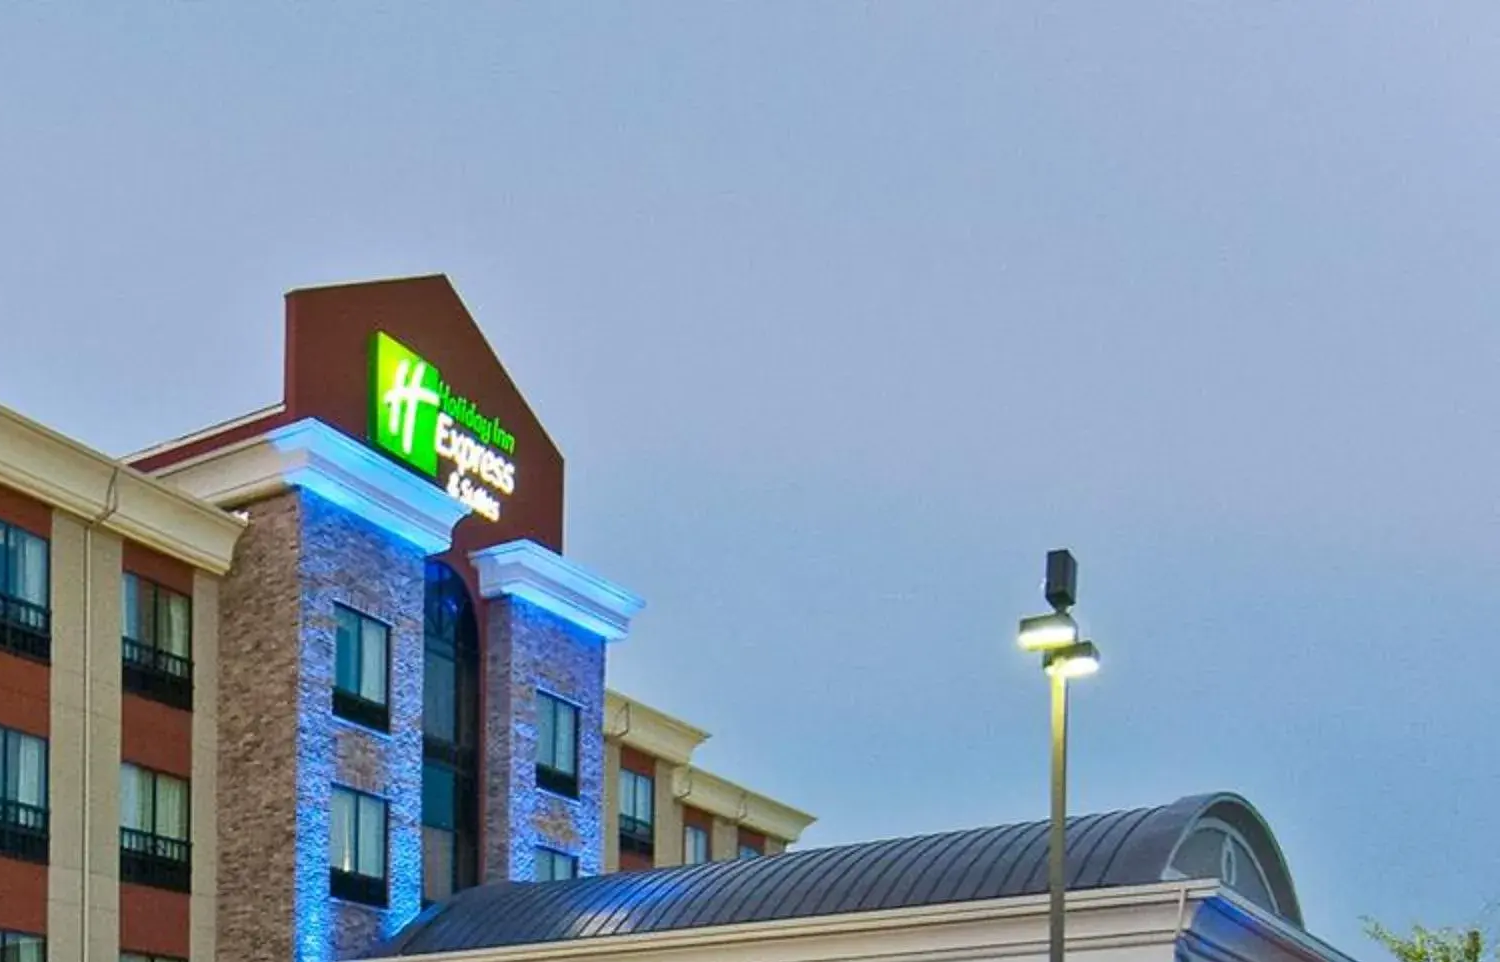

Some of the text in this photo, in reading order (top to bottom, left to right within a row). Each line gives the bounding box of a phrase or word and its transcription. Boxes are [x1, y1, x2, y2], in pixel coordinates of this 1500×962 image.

[436, 412, 515, 495] Express
[439, 381, 515, 455] Holiday Inn
